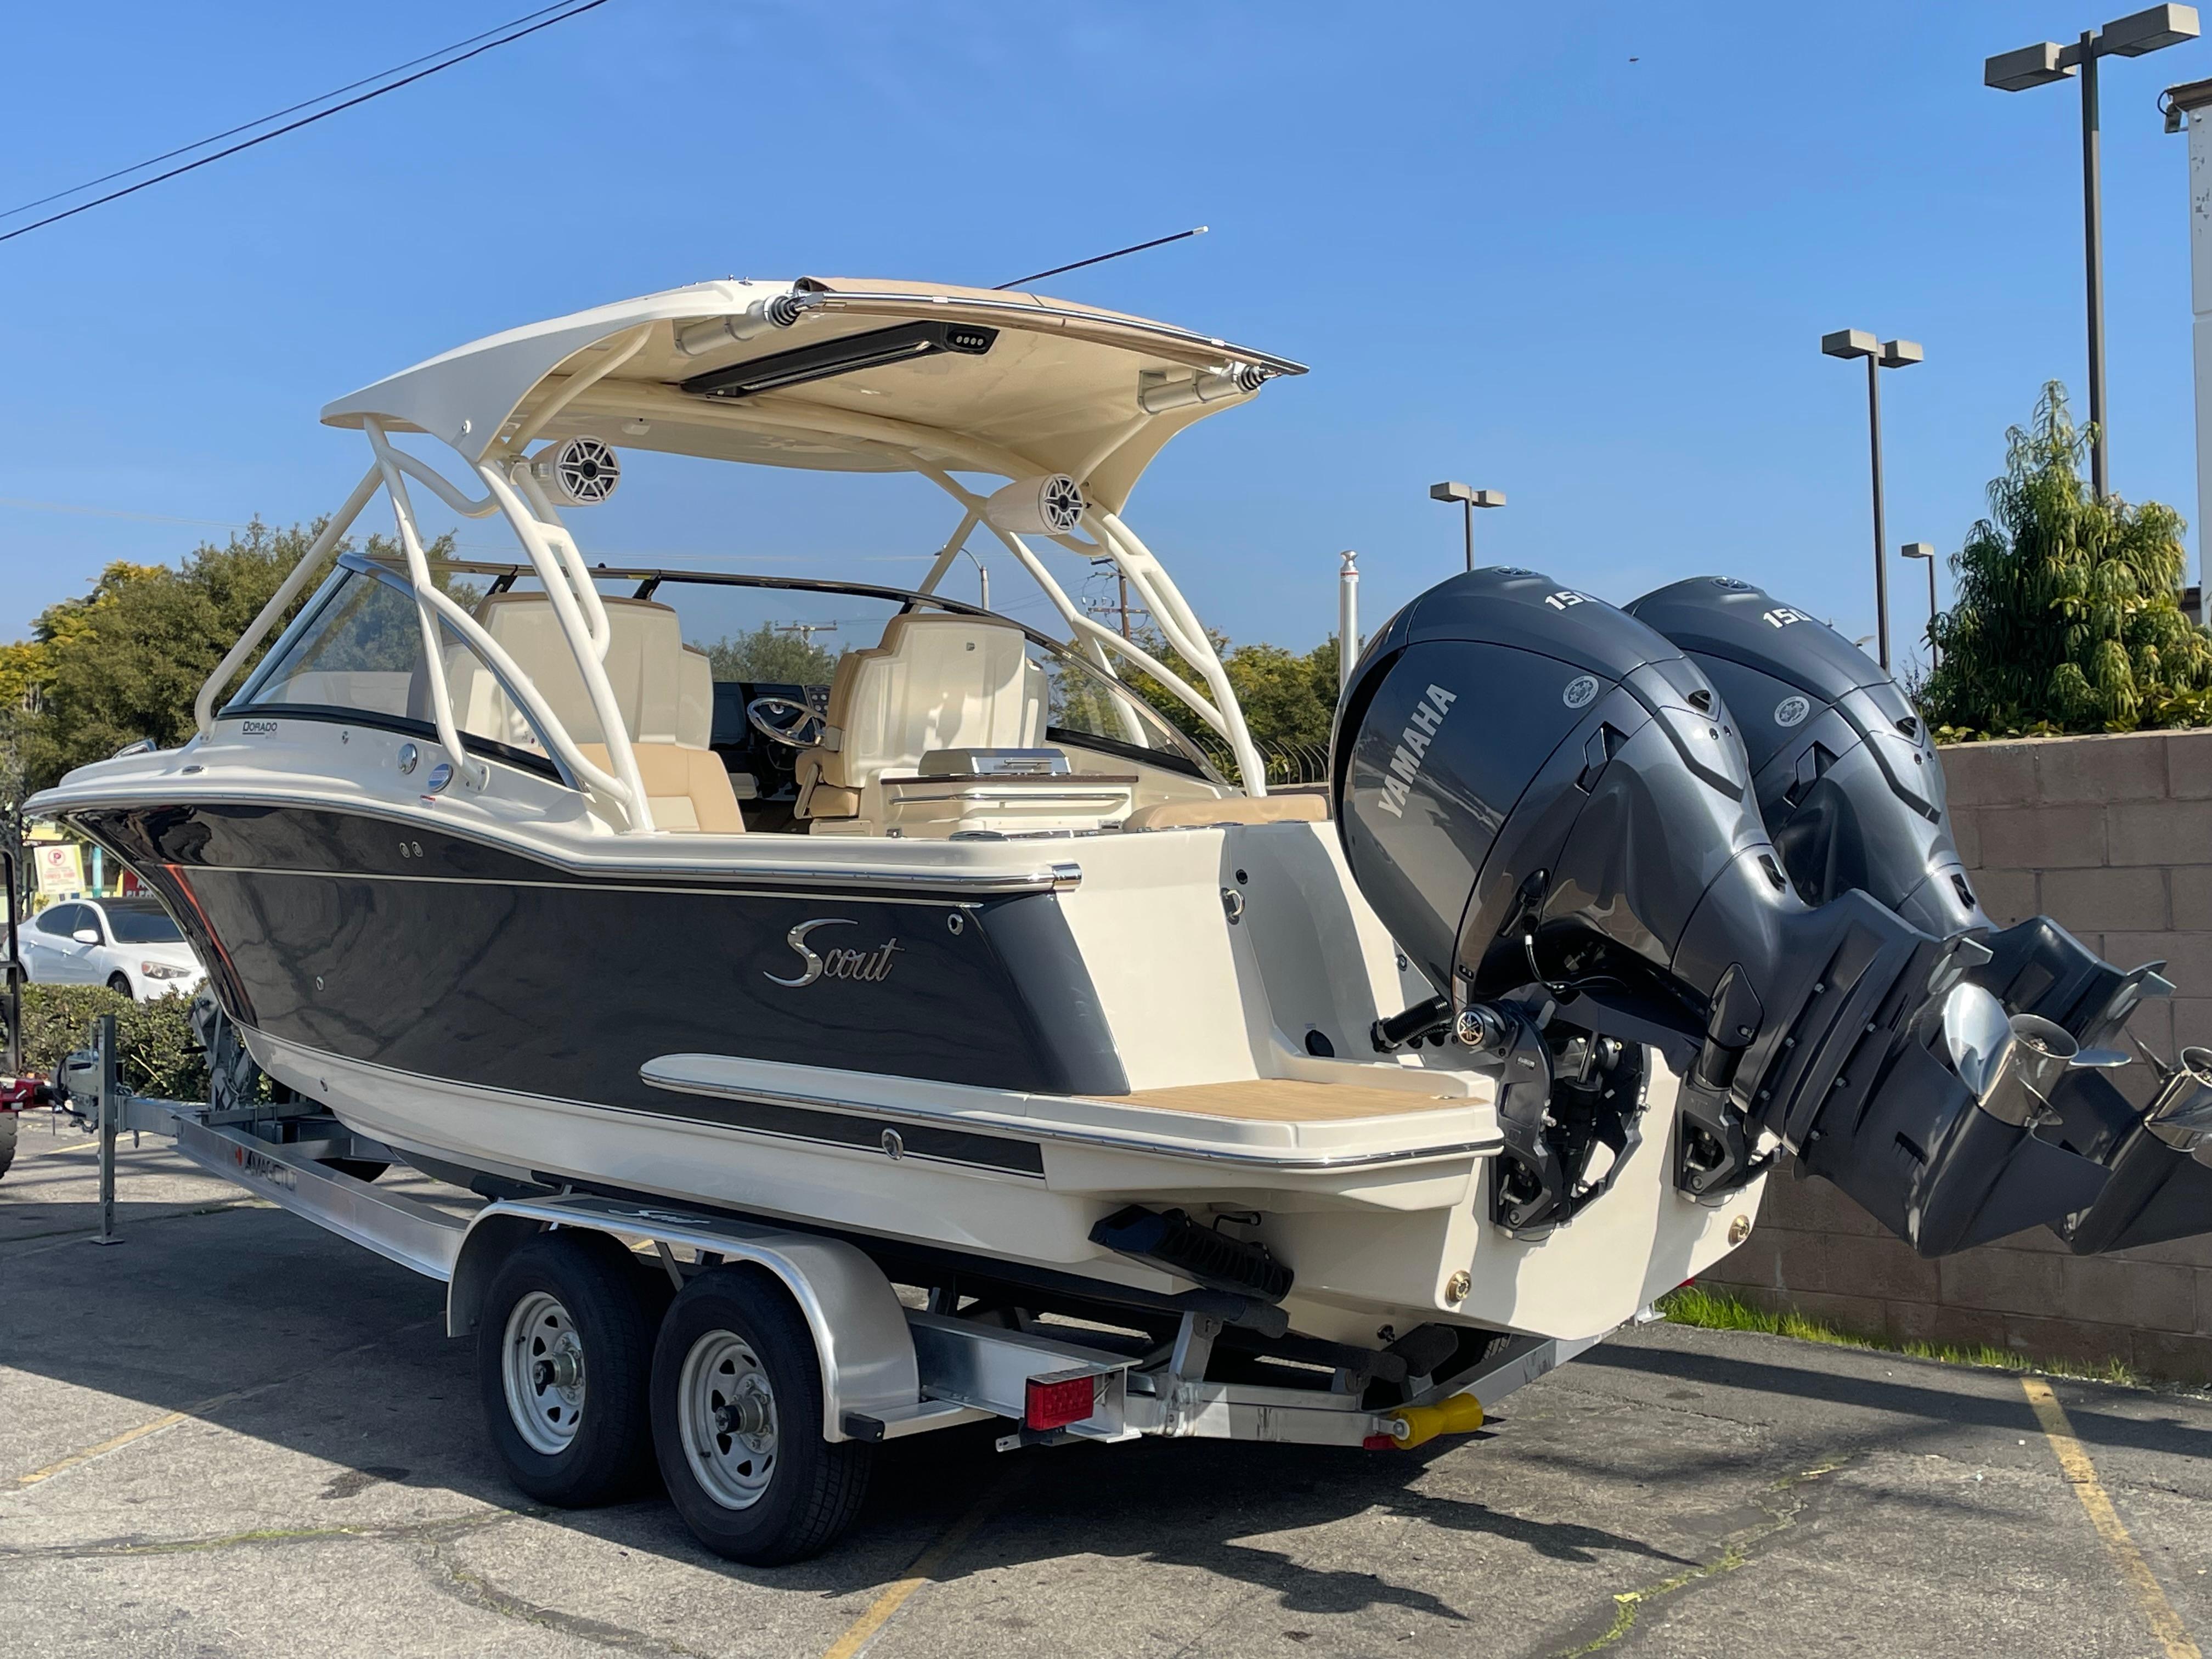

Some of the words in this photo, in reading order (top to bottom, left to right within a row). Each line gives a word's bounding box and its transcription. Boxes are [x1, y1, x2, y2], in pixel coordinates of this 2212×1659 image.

[1545, 591, 1599, 611] 150
[1763, 608, 1813, 629] 150
[242, 720, 278, 732] DORADO
[1378, 684, 1458, 819] YAMAHA
[763, 917, 906, 988] Scout
